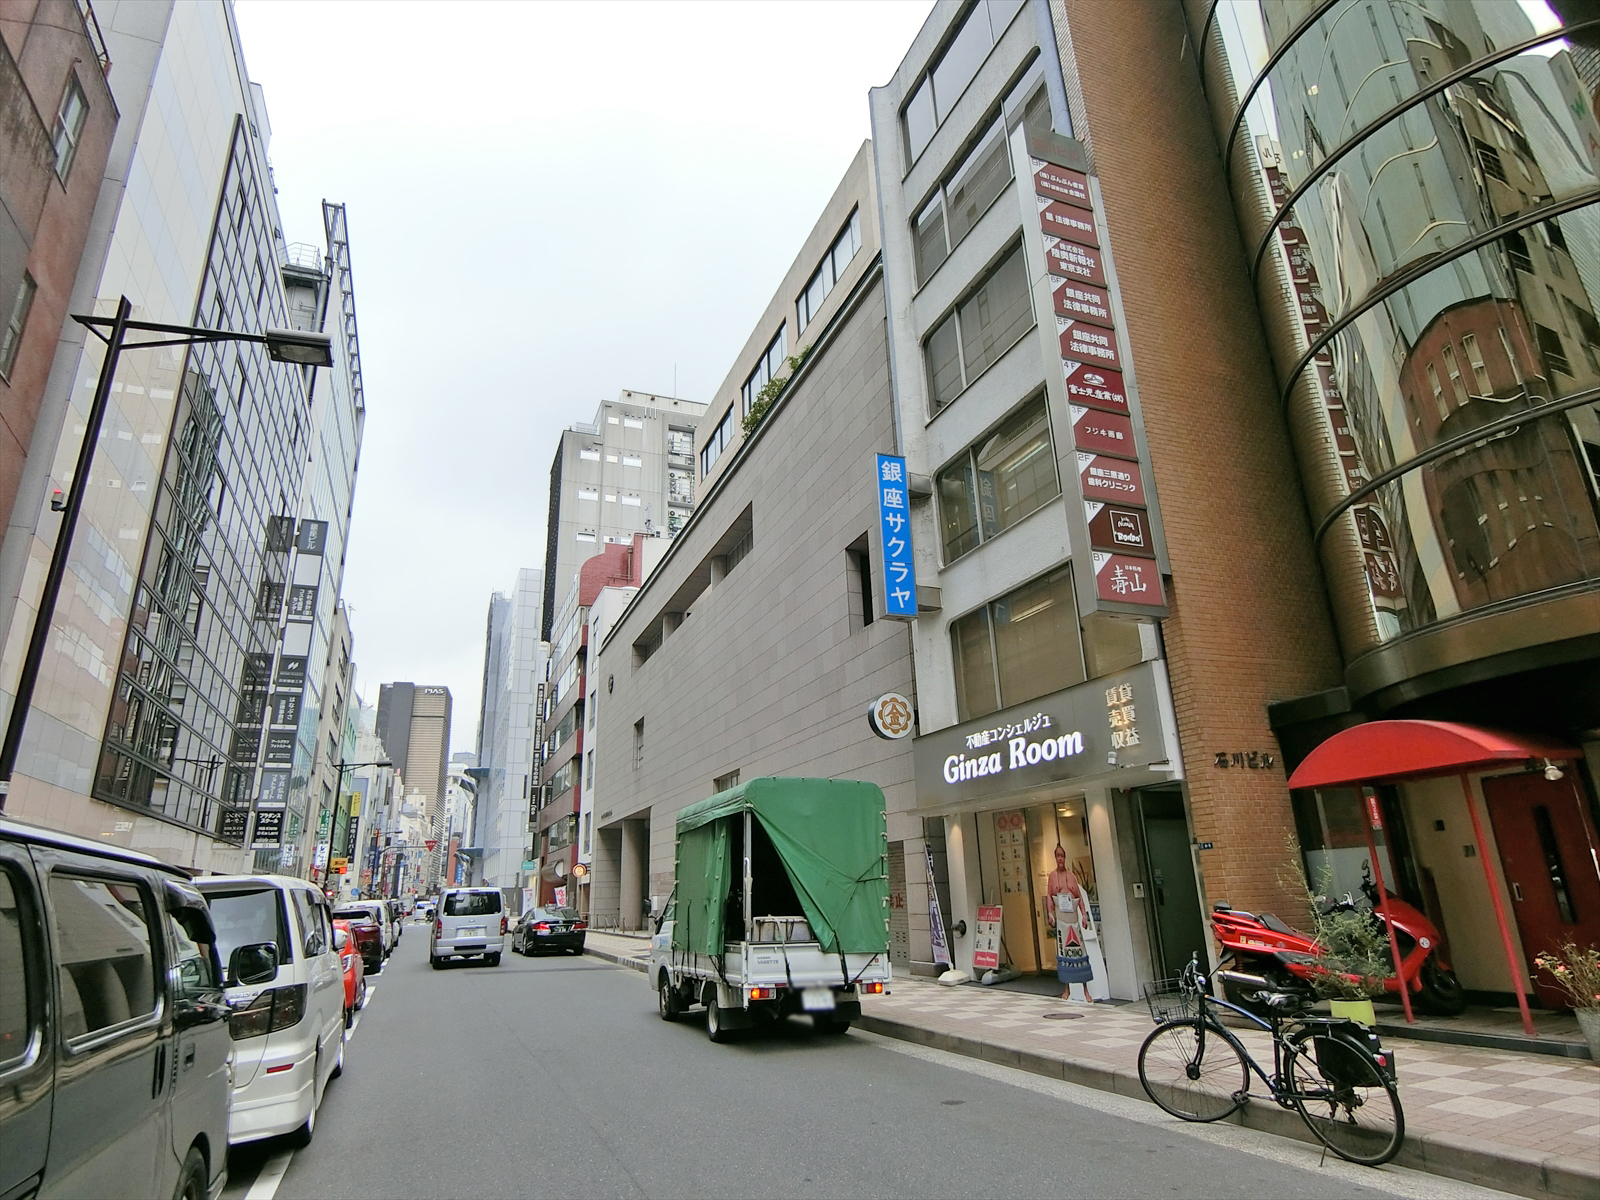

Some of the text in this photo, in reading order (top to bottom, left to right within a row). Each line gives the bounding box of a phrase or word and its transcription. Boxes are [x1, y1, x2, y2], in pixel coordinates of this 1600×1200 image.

[1043, 235, 1055, 243] 7F
[1050, 275, 1062, 284] 6F
[1065, 287, 1102, 305] 銀座共同
[1062, 298, 1108, 319] 法律事務所
[1057, 317, 1069, 326] 5F
[1072, 329, 1109, 347] 銀座共同
[1069, 340, 1115, 361] 法律事務所
[1063, 361, 1076, 370] 4F
[1071, 406, 1083, 414] 3F
[1077, 453, 1091, 462] 2F
[1087, 477, 1136, 493] 歯科クリニック
[1087, 502, 1098, 511] 1F
[881, 460, 911, 609] 銀座サクラヤ
[1093, 552, 1104, 562] B1
[1105, 682, 1134, 707] 賃貸
[1108, 704, 1137, 728] 売買
[965, 712, 1052, 750] 不動産コンシェルジュ
[1110, 727, 1141, 750] 収益
[943, 730, 1084, 785] Ginza Room
[1214, 750, 1274, 769] 石川ビル
